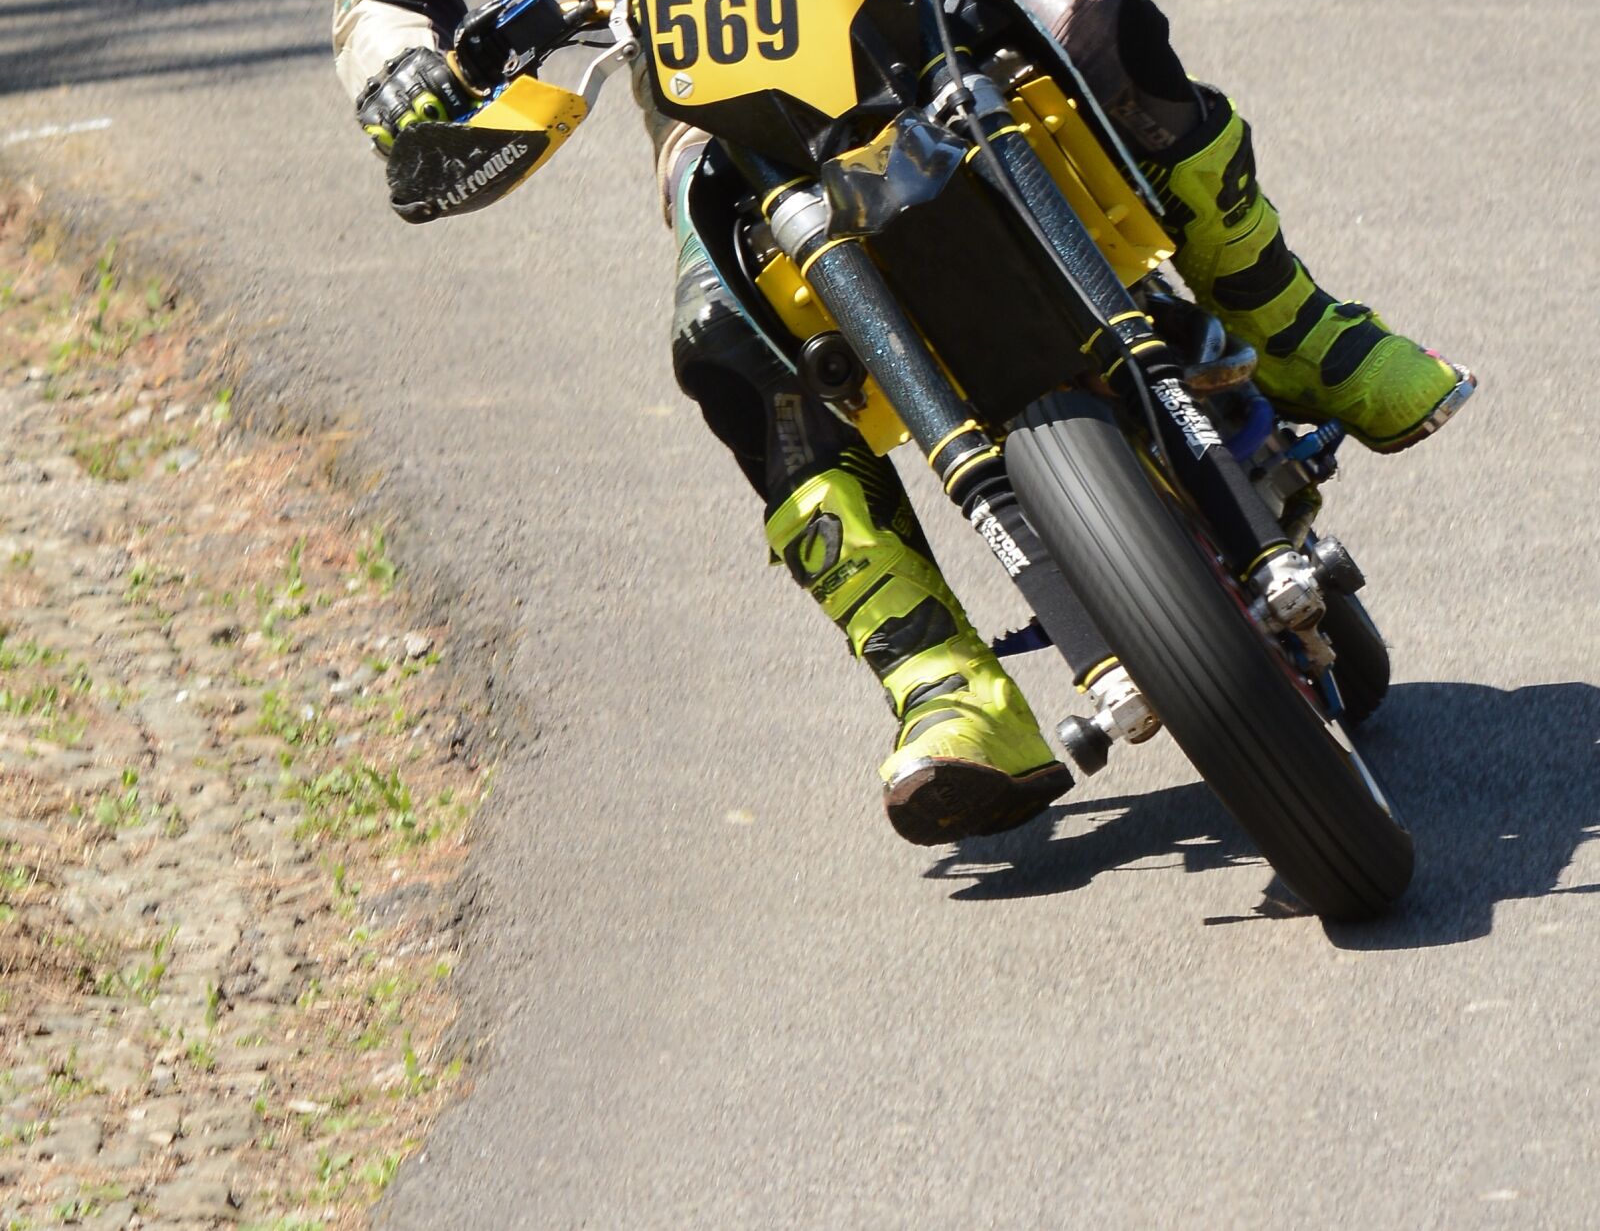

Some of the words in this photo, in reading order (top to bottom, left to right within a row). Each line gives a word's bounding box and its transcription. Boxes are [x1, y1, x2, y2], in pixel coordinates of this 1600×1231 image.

[1150, 385, 1202, 448] FACTORY
[975, 501, 1031, 567] FACTORY
[983, 529, 1021, 577] IMAGE
